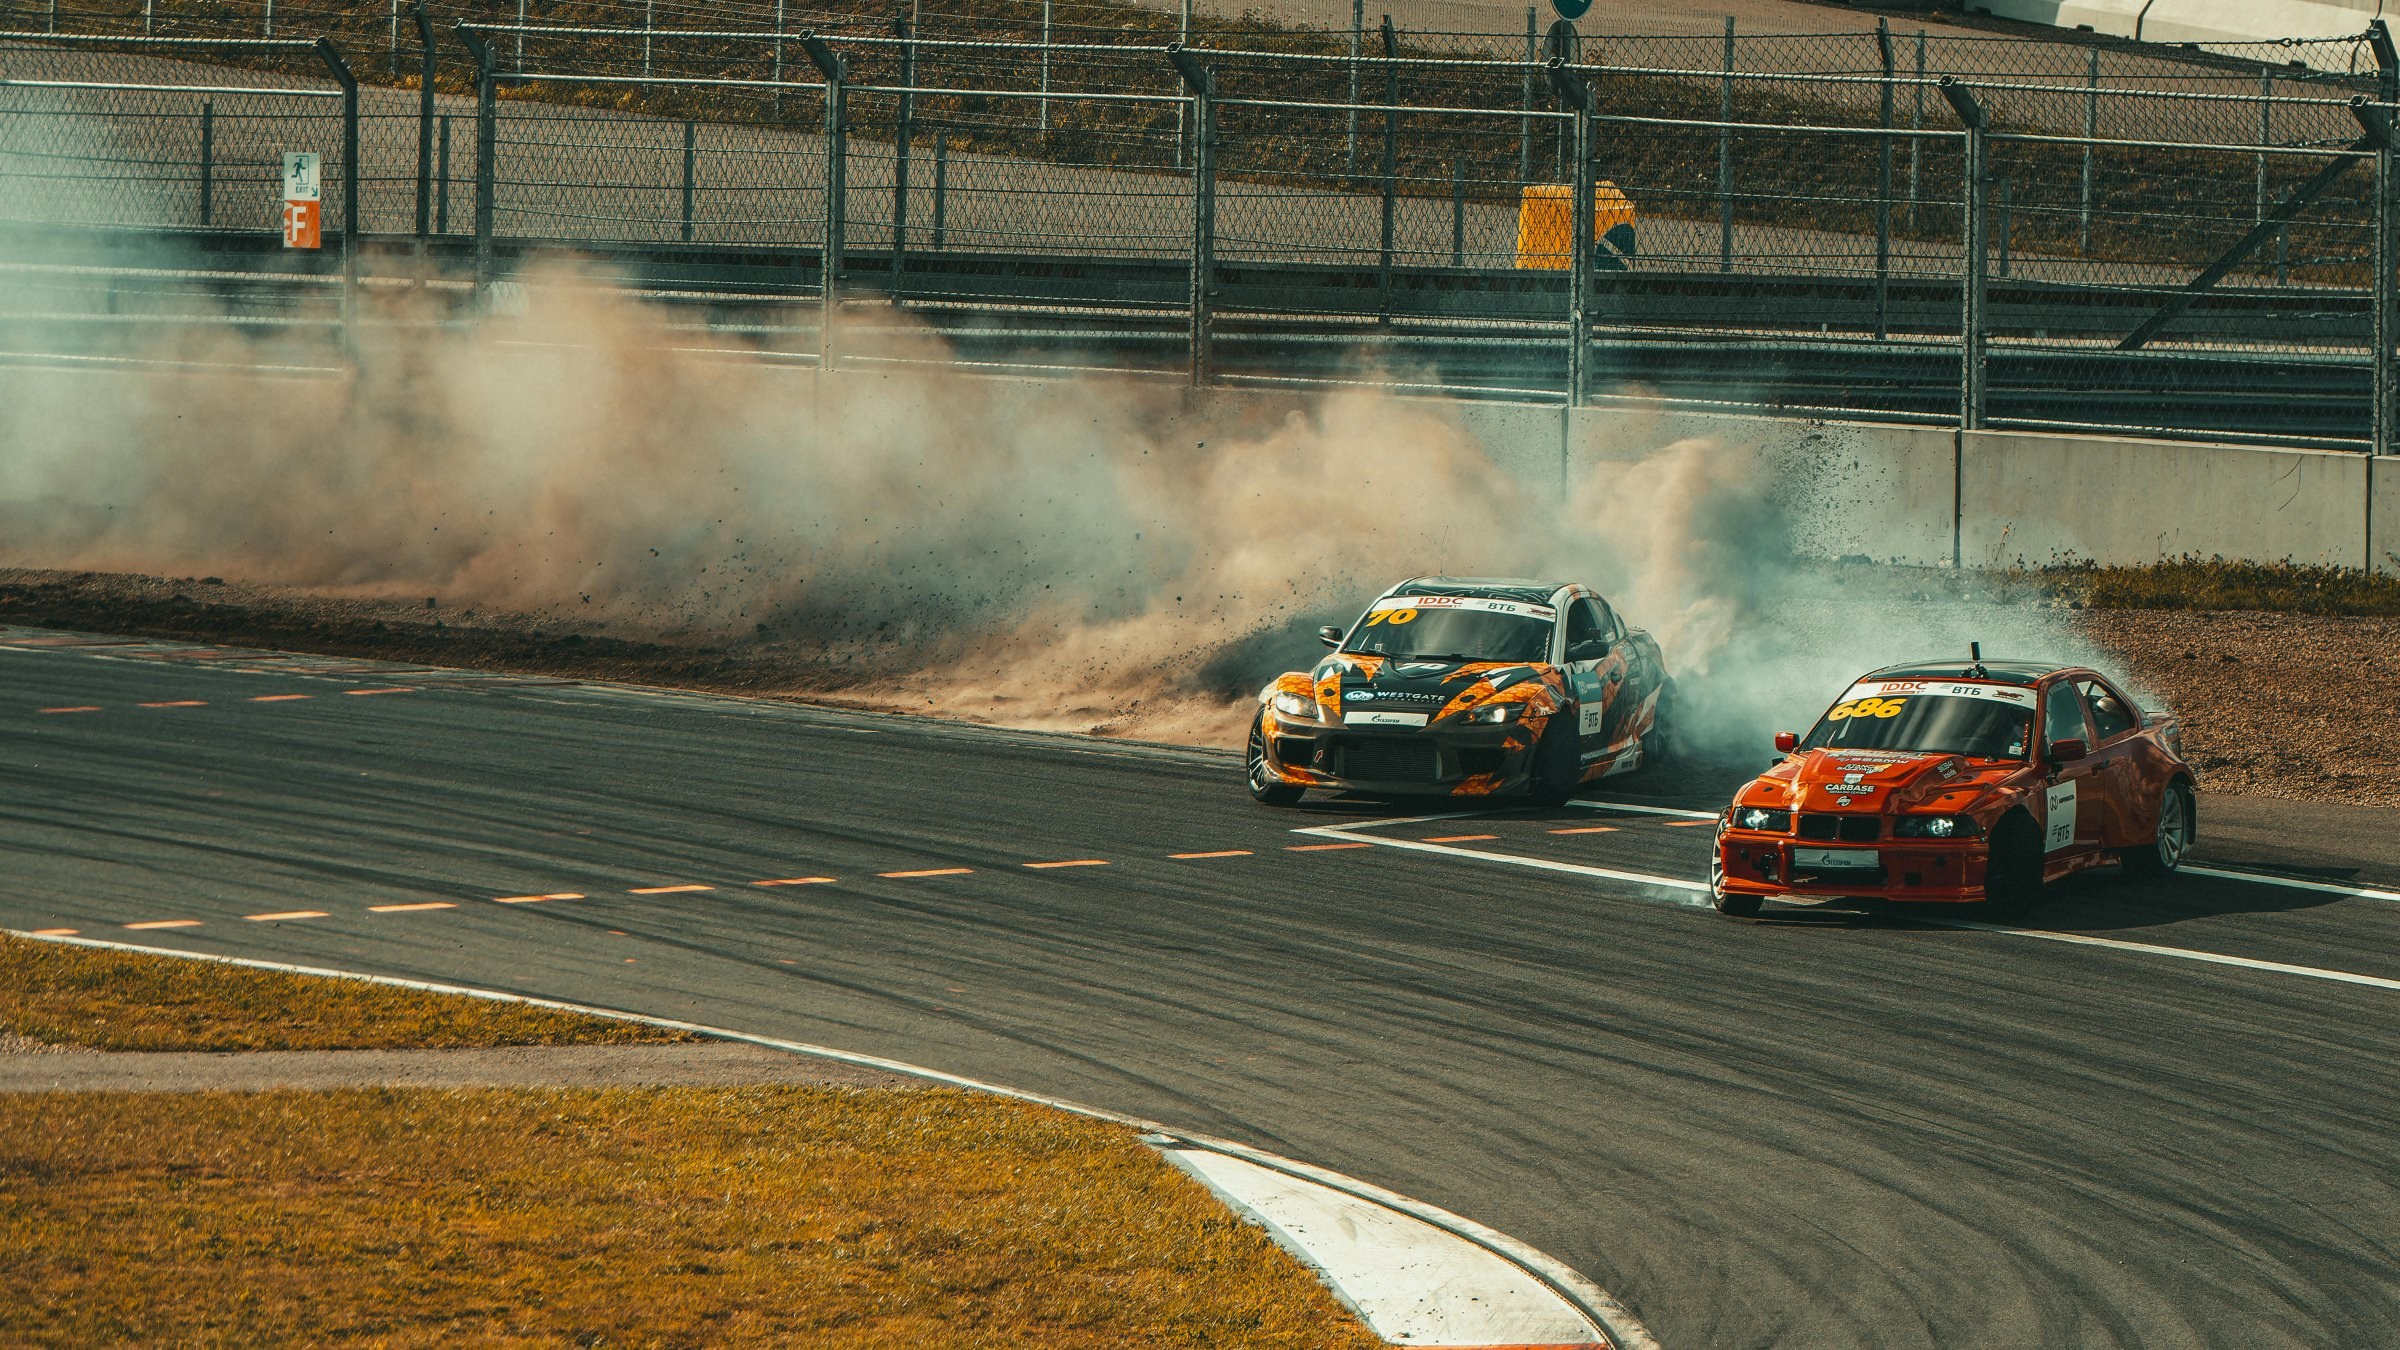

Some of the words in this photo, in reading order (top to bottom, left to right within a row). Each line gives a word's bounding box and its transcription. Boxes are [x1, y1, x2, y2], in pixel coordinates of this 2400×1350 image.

[295, 186, 309, 194] EXIT
[292, 206, 307, 242] F
[1417, 597, 1465, 605] IDDC
[1365, 608, 1418, 628] 70
[1880, 682, 1929, 691] IDDC
[1377, 691, 1446, 701] WESTGATE
[1828, 698, 1908, 721] 686
[1825, 784, 1875, 793] CARBASE
